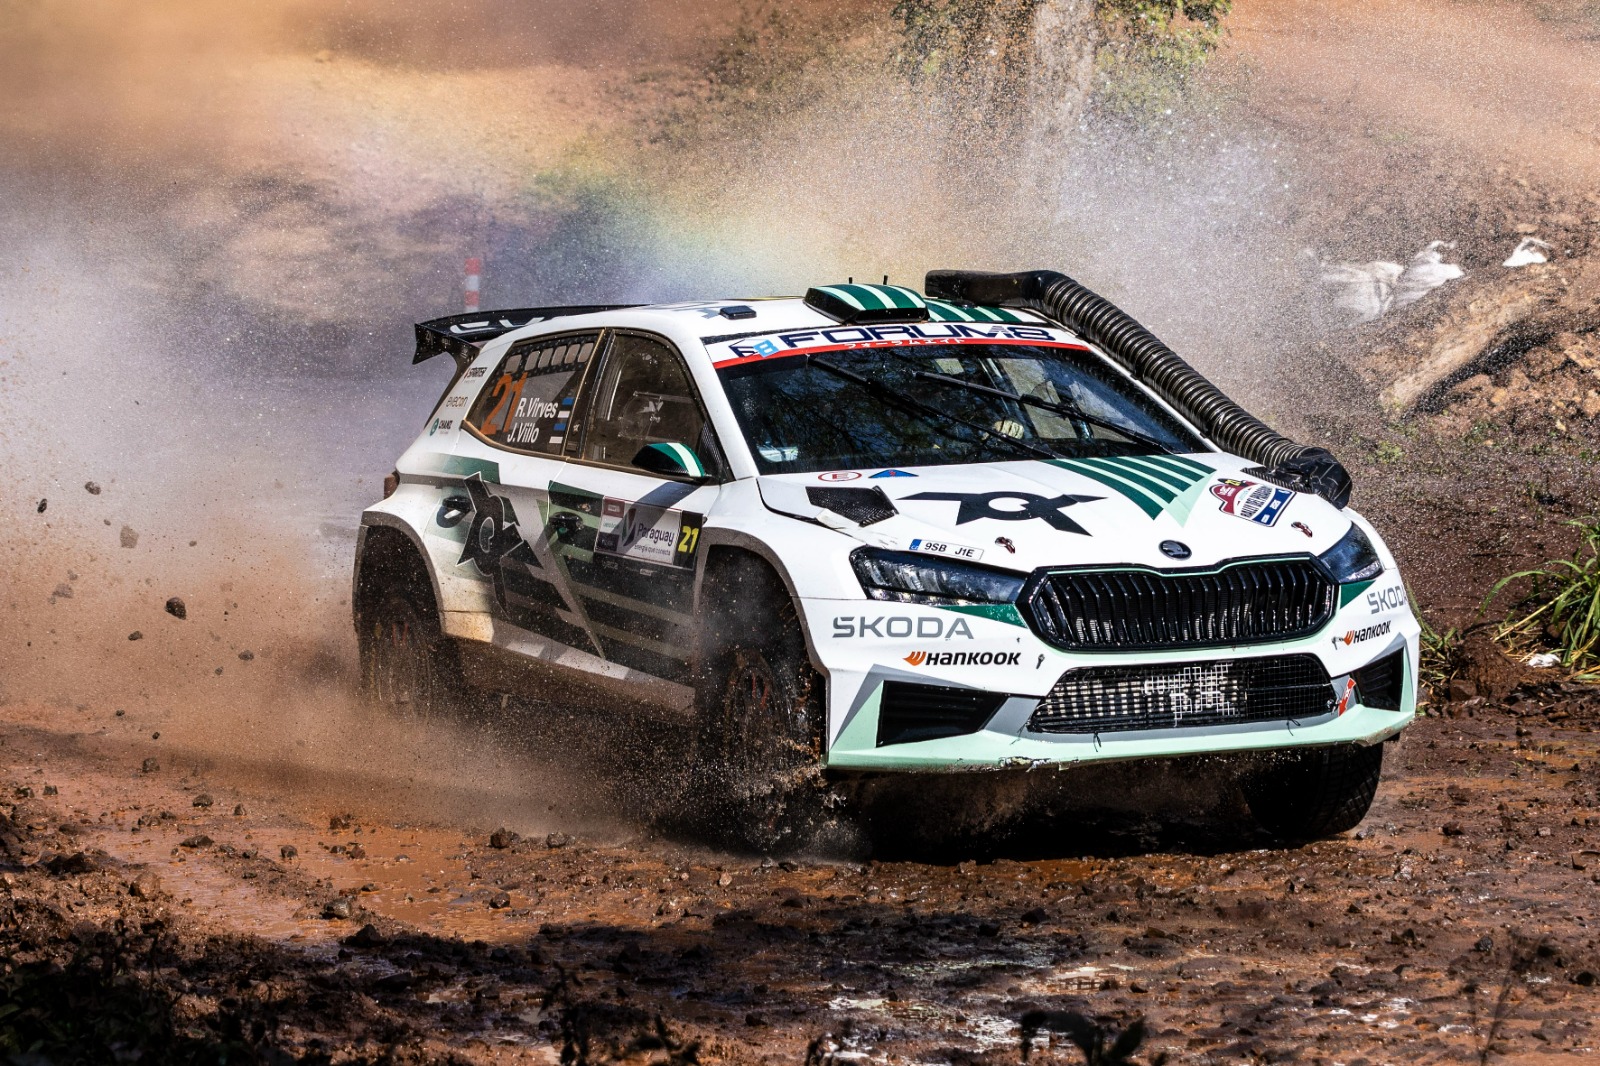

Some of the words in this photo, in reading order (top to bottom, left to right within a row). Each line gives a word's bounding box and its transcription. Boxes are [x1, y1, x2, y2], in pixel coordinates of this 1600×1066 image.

[778, 325, 1056, 348] FORUM8
[480, 371, 528, 435] 21
[515, 397, 559, 418] R.Virves
[637, 523, 675, 547] Paraguay
[677, 525, 699, 553] 21
[924, 542, 947, 552] 9SB
[954, 547, 975, 558] J1E
